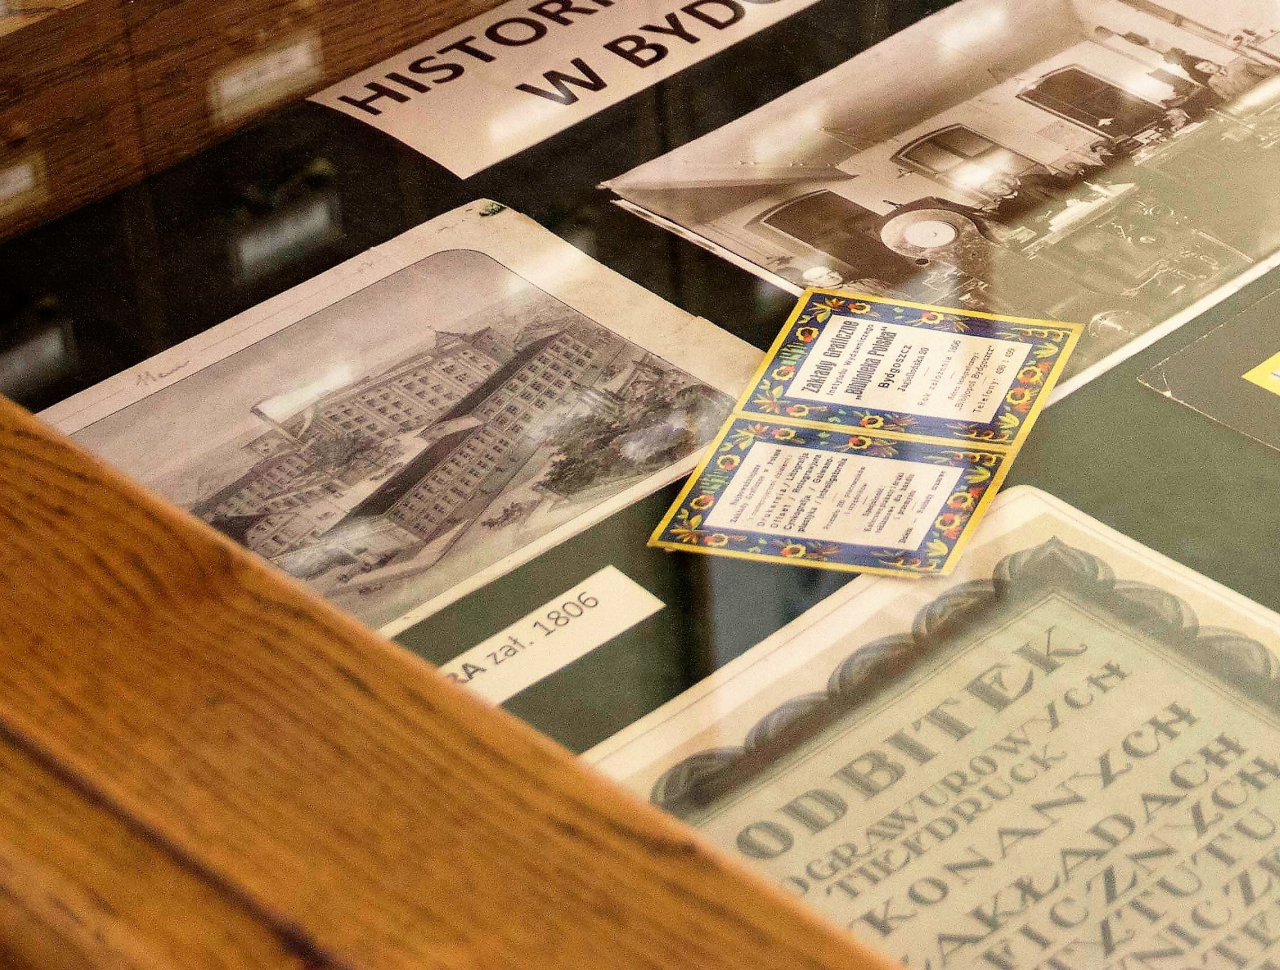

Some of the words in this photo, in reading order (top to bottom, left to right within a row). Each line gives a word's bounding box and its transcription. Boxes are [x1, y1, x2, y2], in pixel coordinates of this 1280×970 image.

[514, 57, 608, 105] W
[800, 360, 838, 394] Zakłady
[822, 320, 860, 358] Graficzne
[842, 324, 875, 366] Wydawniczego
[877, 344, 913, 389] Bydgoszcz
[917, 393, 931, 406] Rok
[770, 504, 791, 529] Offset
[486, 635, 535, 666] zał.
[532, 591, 599, 637] 1806
[735, 625, 1089, 861] ODBITEK
